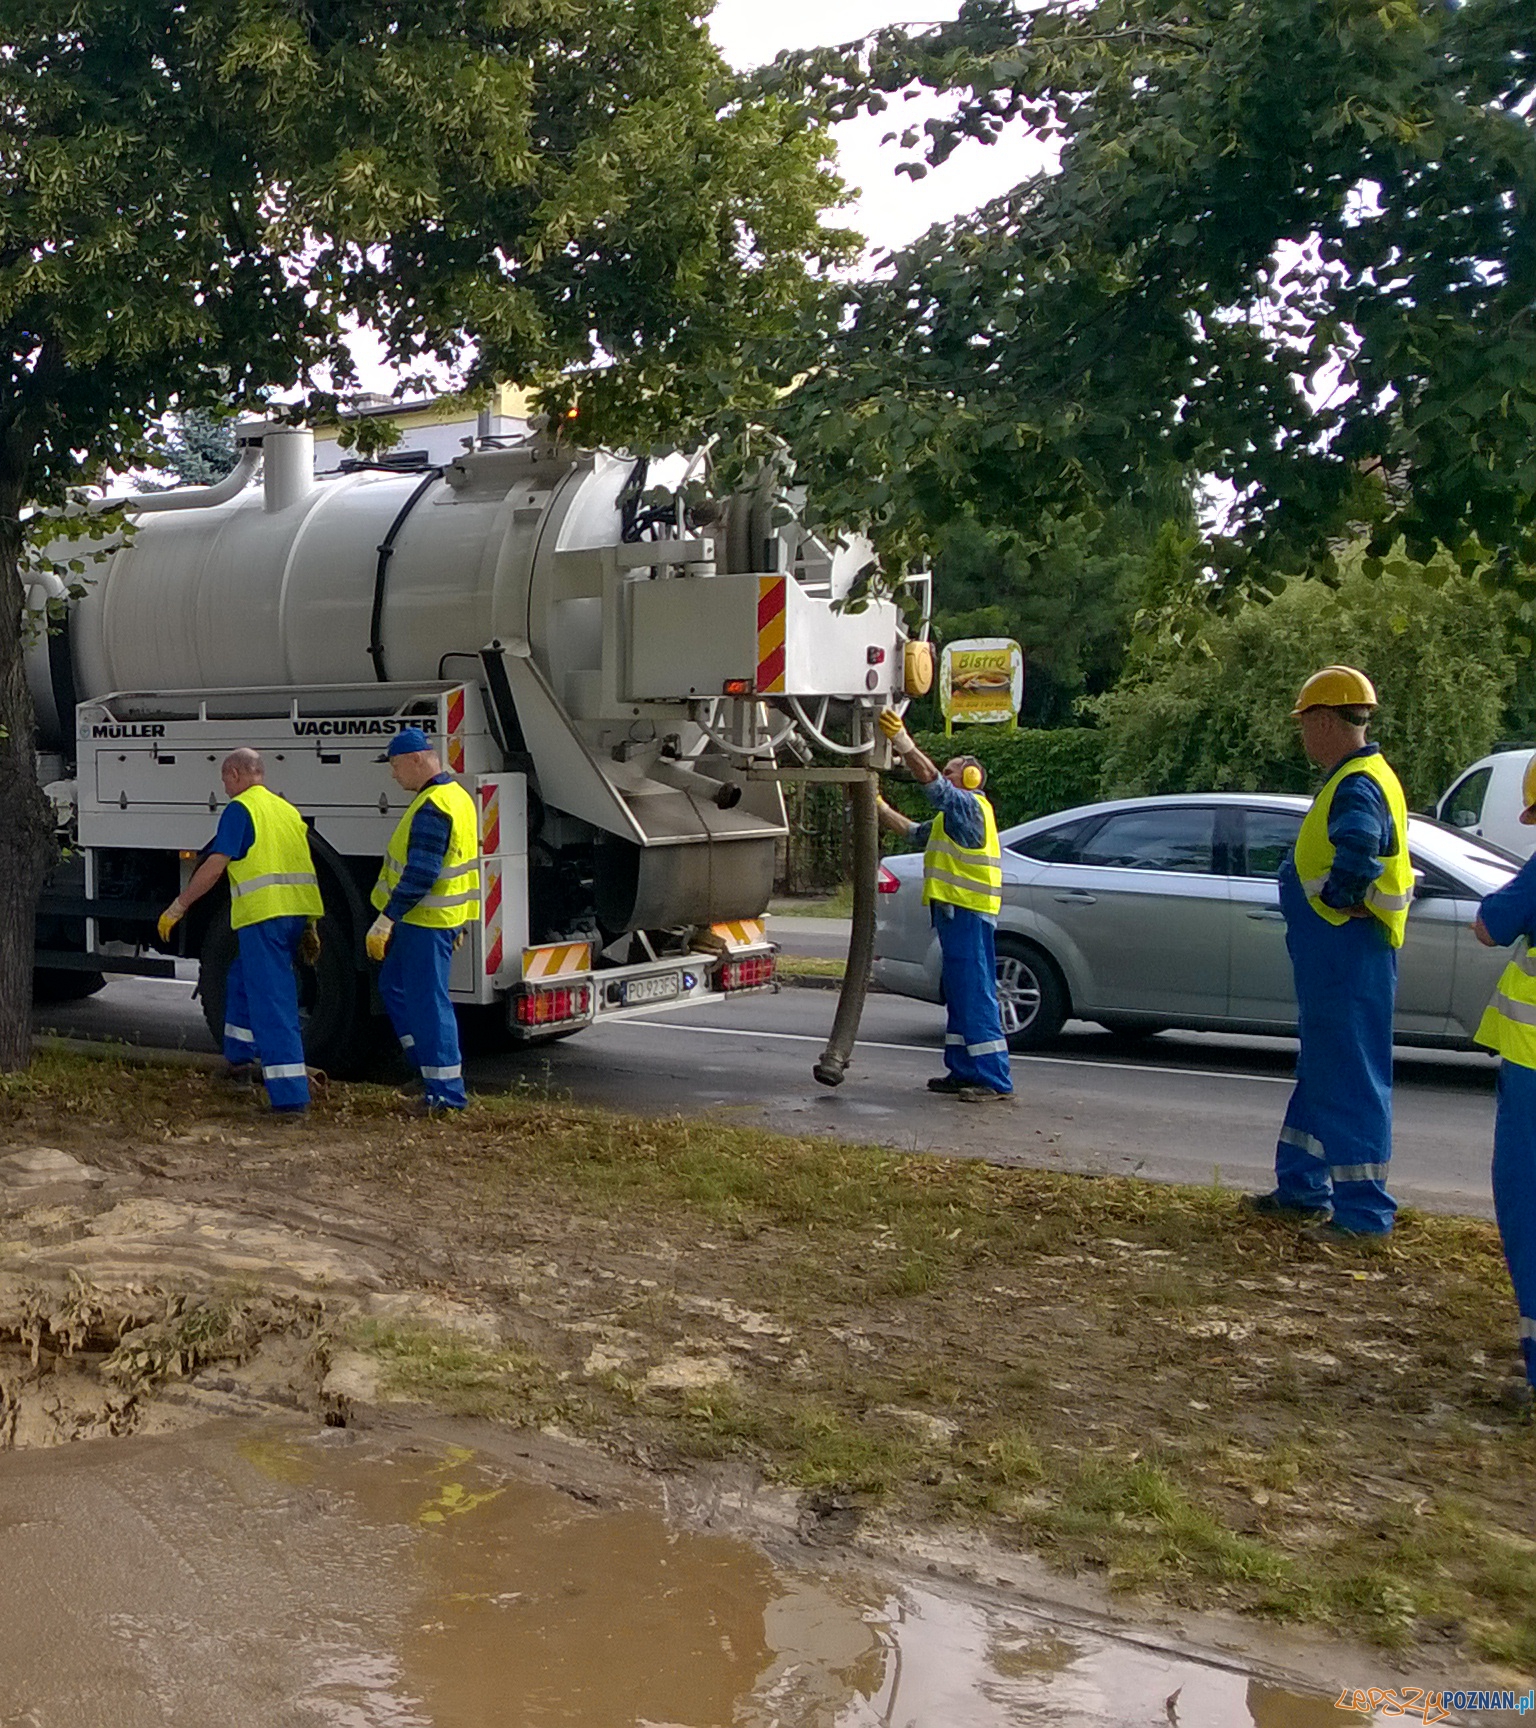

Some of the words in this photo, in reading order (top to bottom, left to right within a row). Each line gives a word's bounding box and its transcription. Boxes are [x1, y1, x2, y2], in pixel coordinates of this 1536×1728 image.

[92, 724, 165, 738] MÜLLER
[293, 719, 437, 735] VACUMASTER
[629, 982, 643, 999] PO
[646, 976, 676, 996] 923FS
